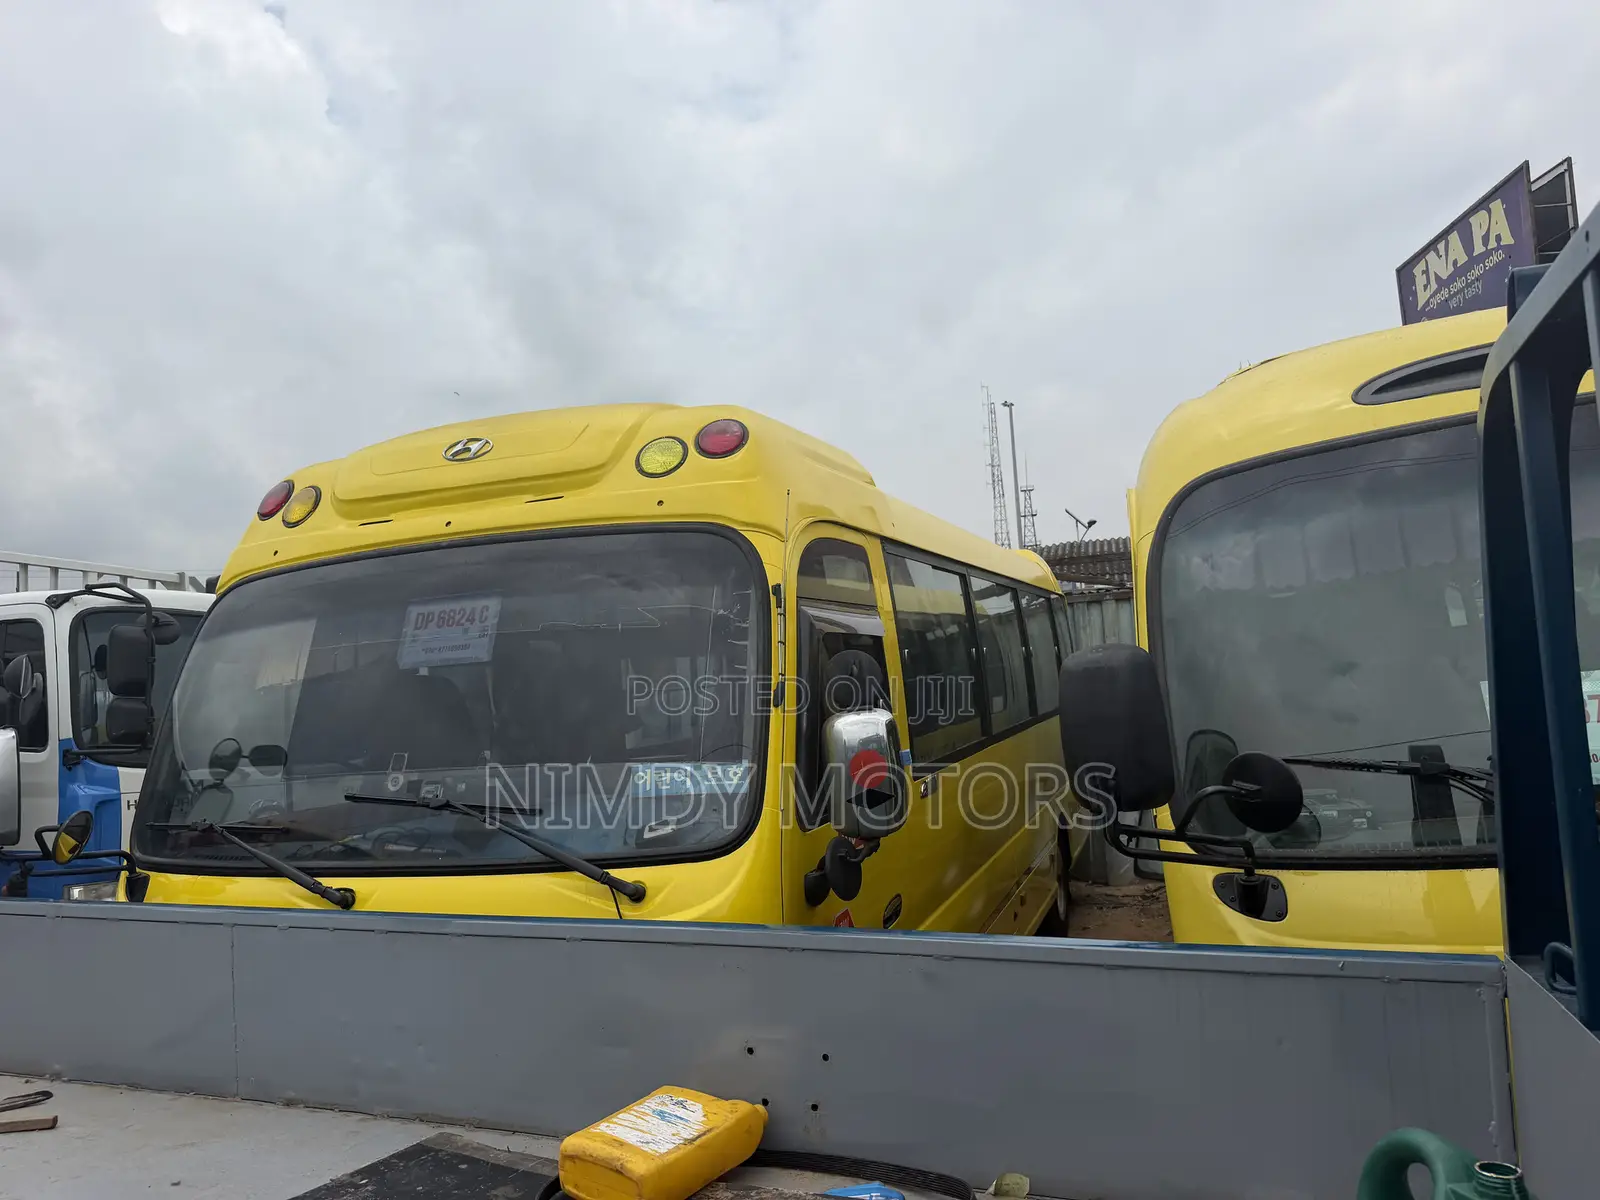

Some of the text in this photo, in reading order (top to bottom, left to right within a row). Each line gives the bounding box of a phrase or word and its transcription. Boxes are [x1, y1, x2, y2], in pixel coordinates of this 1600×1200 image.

[1412, 199, 1514, 310] ENA PA
[1449, 277, 1466, 294] soko
[1466, 264, 1484, 283] soko
[1484, 250, 1505, 270] soko.
[1448, 279, 1483, 310] very tasty
[633, 766, 691, 791] 어린이
